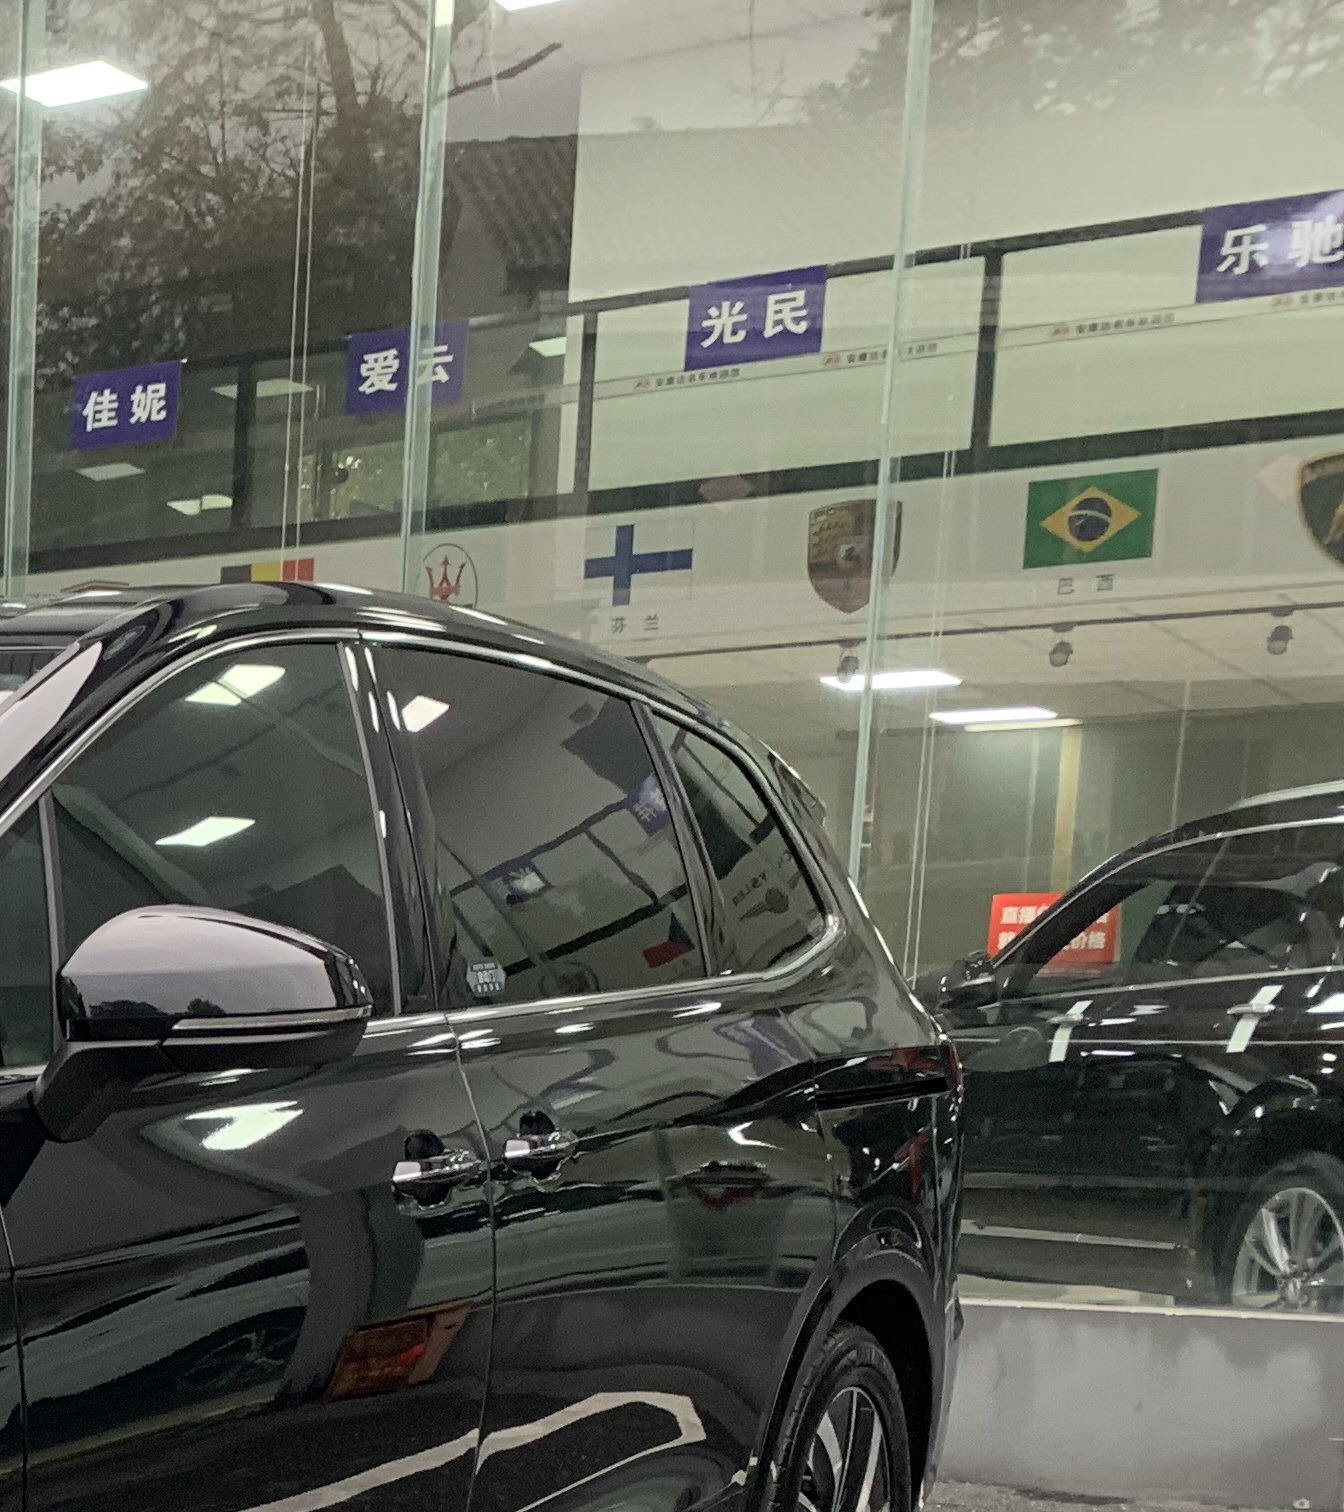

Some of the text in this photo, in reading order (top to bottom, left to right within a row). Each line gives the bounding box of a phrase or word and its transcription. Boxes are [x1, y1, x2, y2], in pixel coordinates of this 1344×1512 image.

[1216, 214, 1344, 276] 乐驰
[700, 288, 809, 349] 光民
[358, 344, 454, 395] 爱云
[82, 382, 168, 432] 佳妮
[1057, 573, 1115, 595] 巴西
[611, 613, 660, 634] 芬兰
